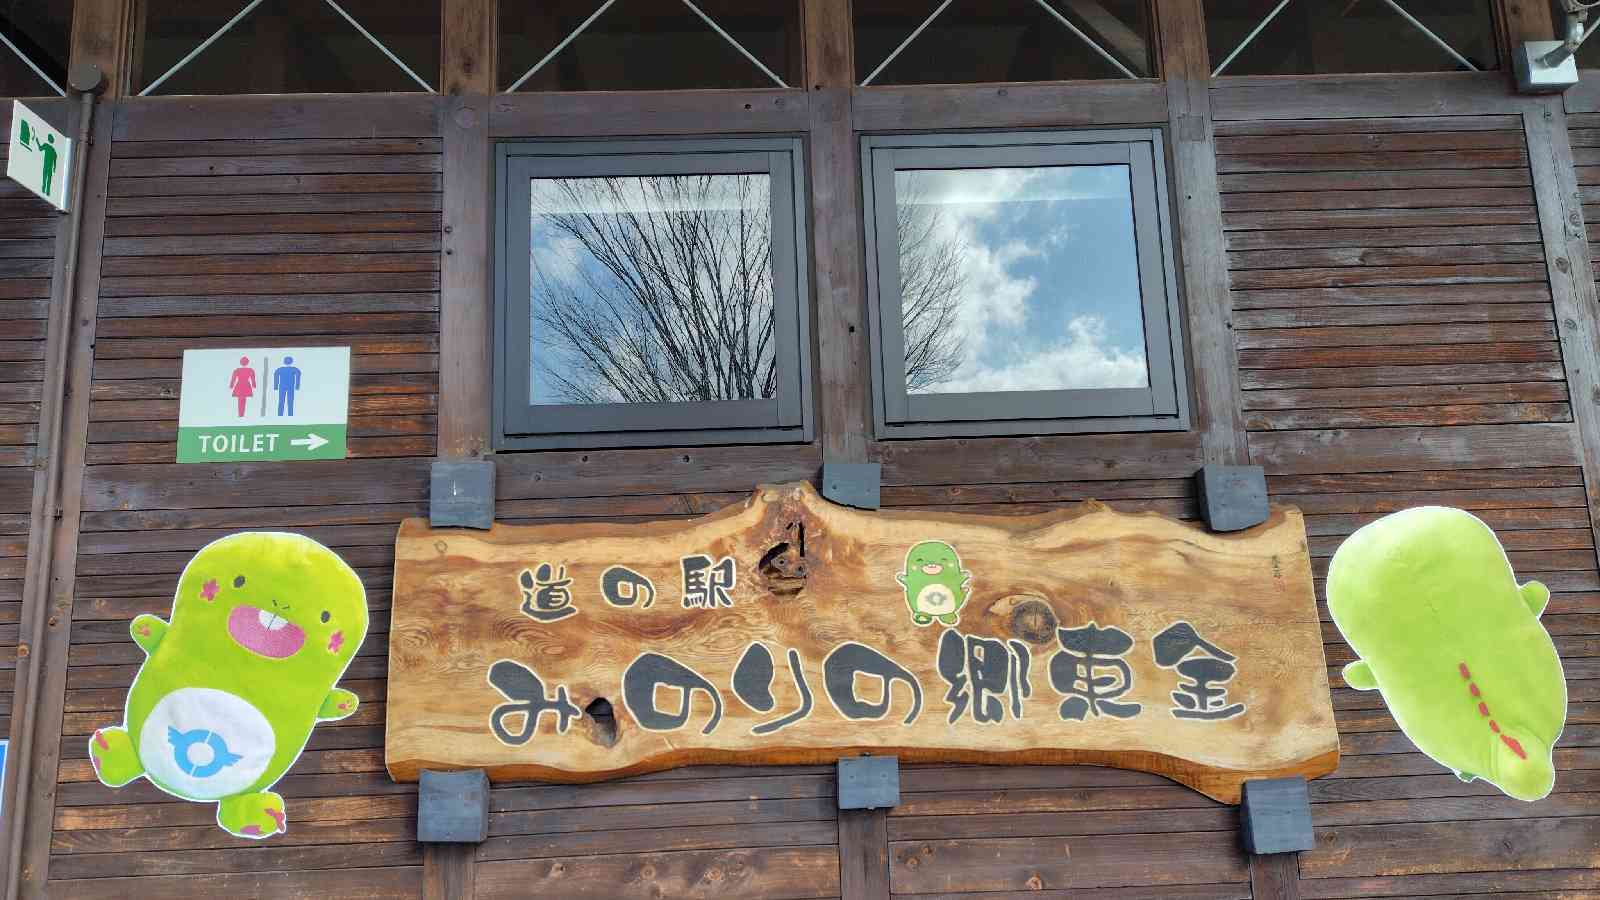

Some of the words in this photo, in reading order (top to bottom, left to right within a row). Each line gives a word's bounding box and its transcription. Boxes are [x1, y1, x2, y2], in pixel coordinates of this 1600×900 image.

[198, 433, 280, 453] TOILET
[519, 554, 737, 623] 道の駅
[487, 620, 1246, 746] みのりの郷東金
